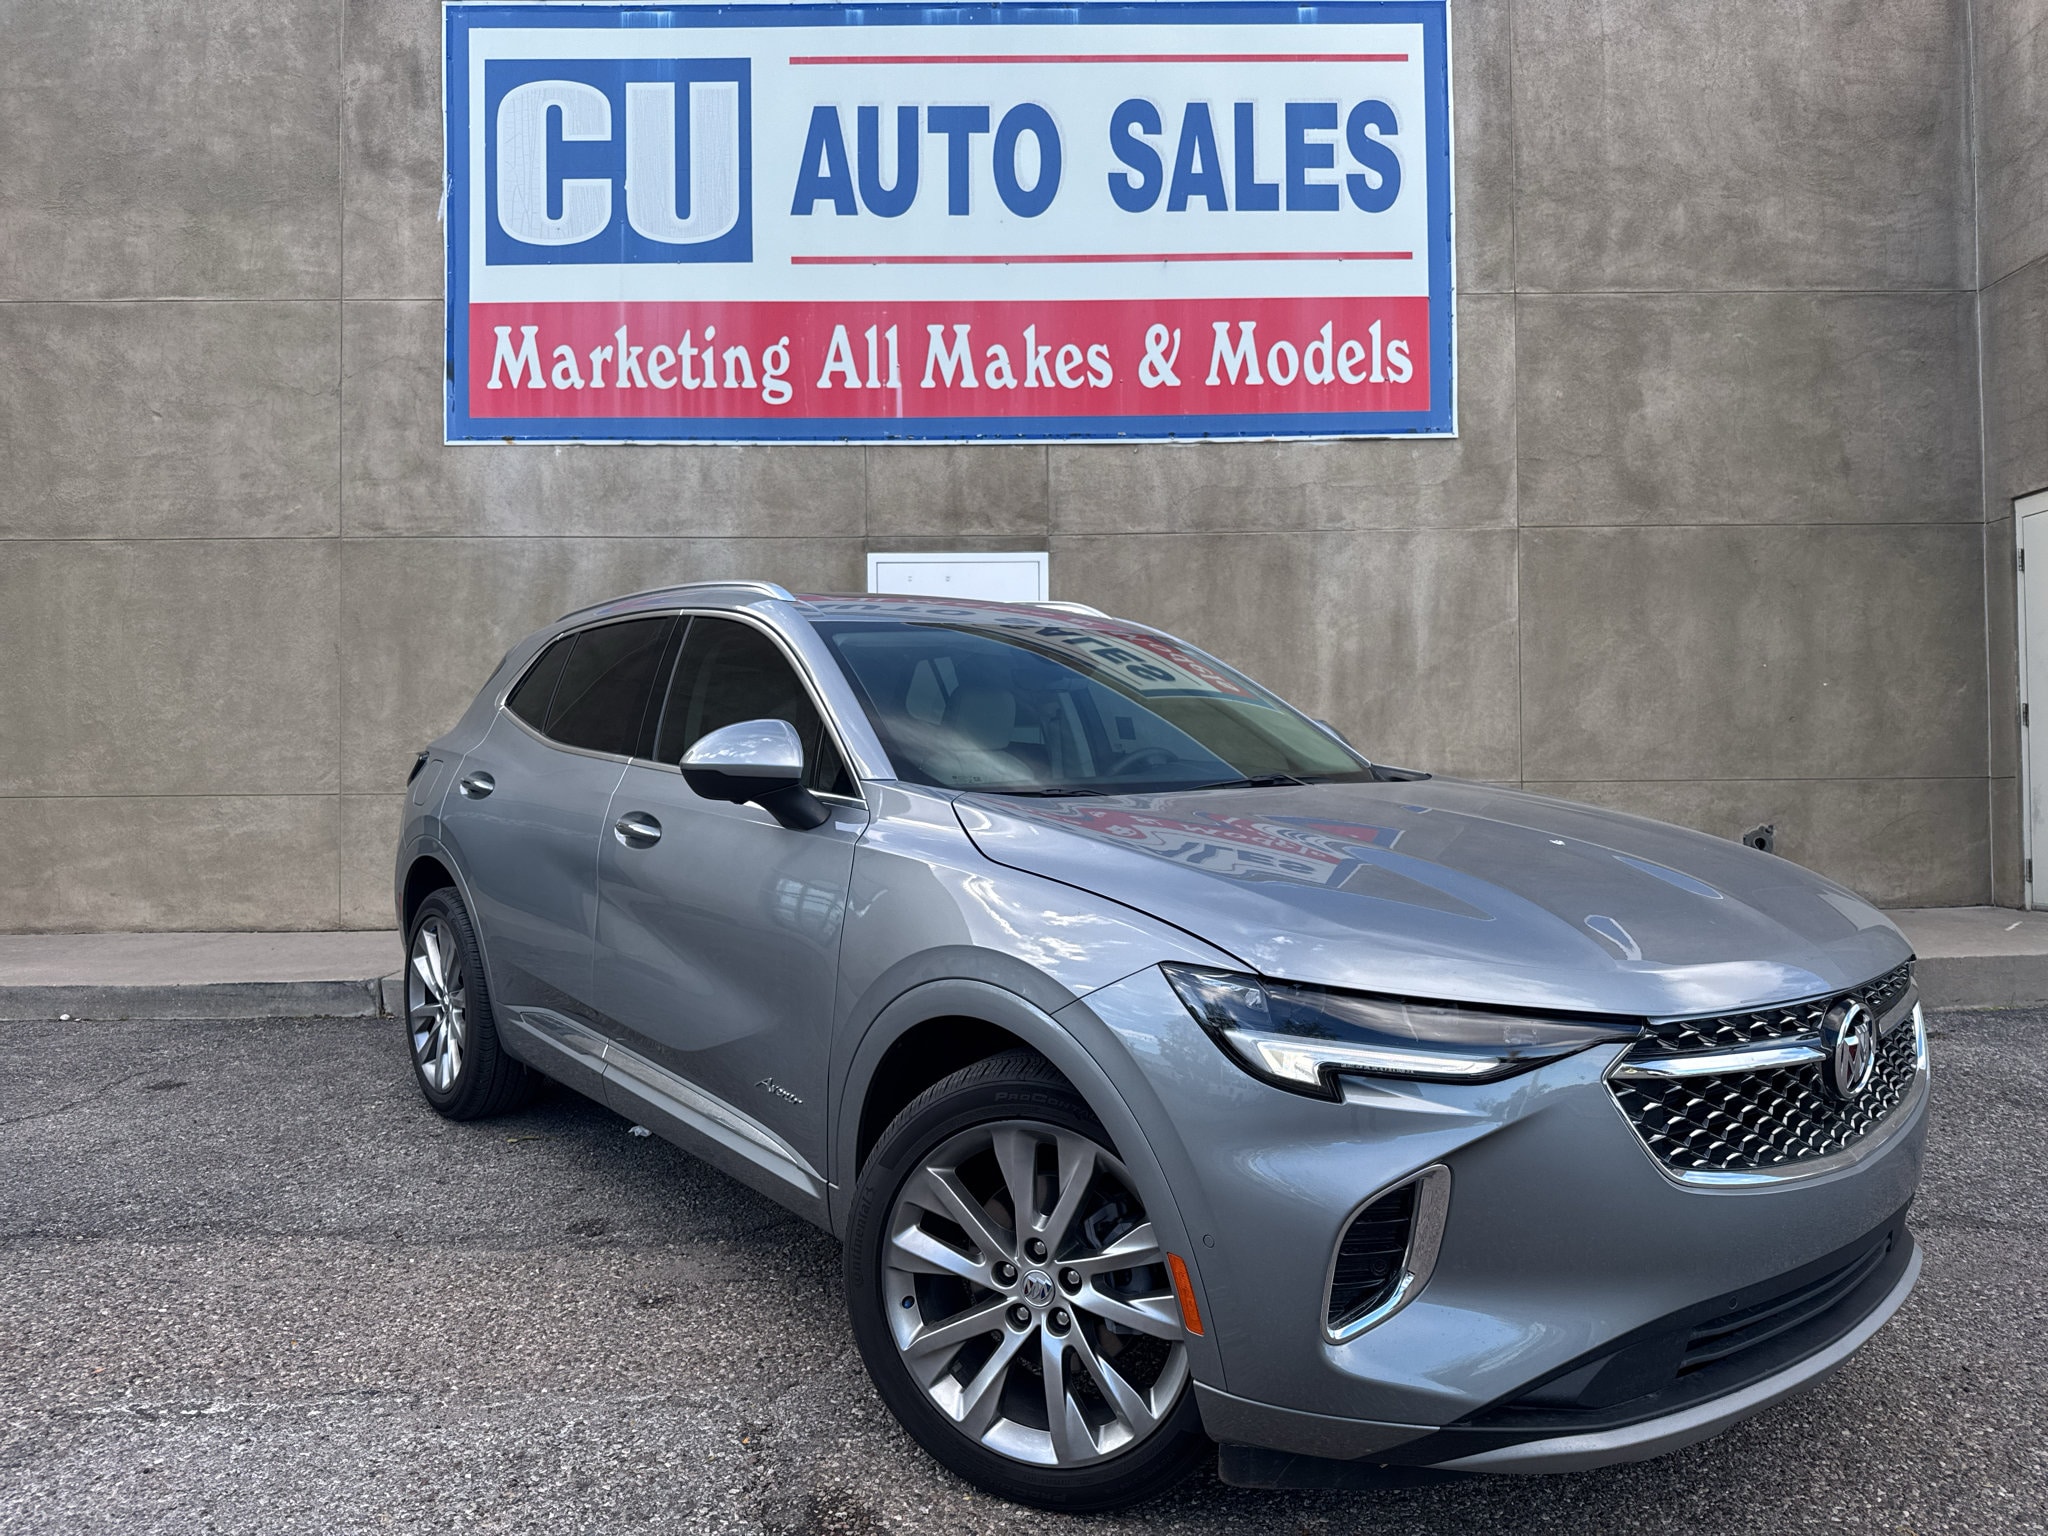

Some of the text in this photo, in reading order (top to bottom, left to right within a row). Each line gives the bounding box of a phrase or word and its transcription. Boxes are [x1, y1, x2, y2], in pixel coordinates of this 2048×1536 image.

[497, 79, 1402, 247] CU AUTO SALES
[487, 320, 1413, 405] Marketing All Makes & Models
